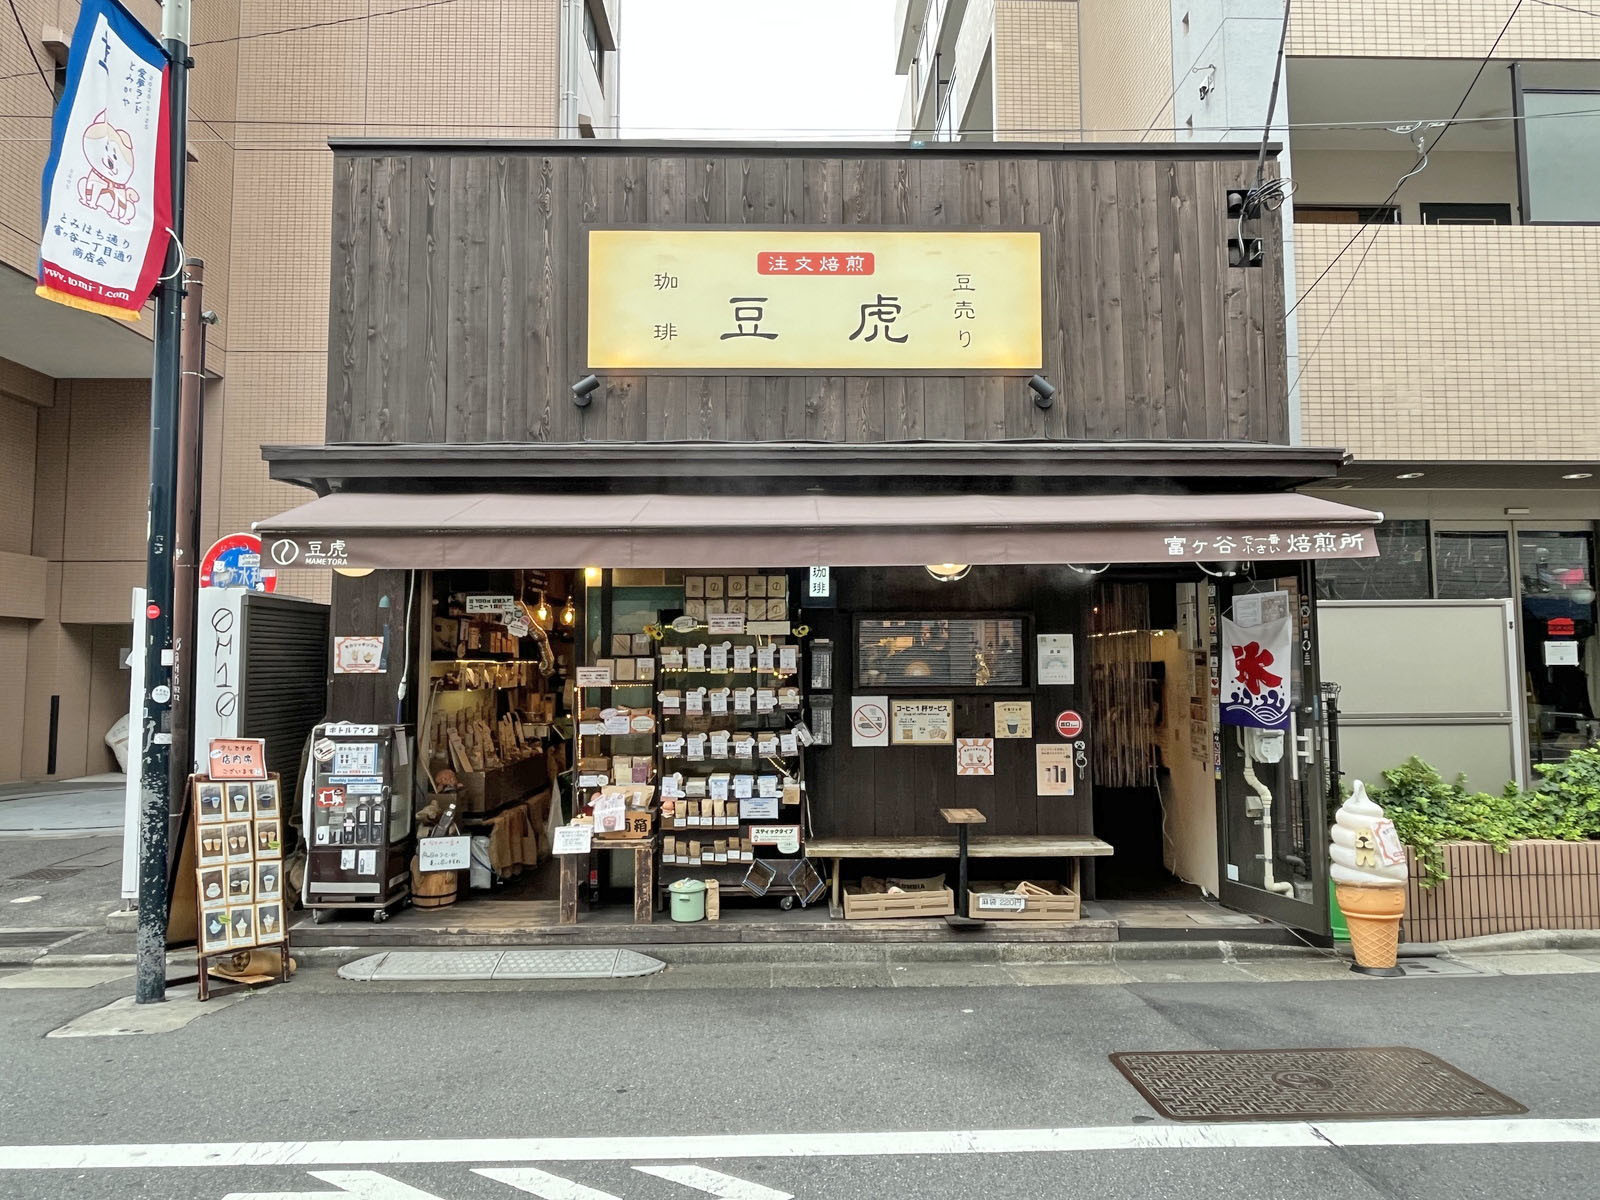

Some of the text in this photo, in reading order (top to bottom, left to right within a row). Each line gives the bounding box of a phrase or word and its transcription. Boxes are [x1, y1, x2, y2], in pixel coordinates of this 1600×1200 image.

[59, 212, 131, 249] とみはち通り
[72, 247, 107, 267] 商店会
[767, 255, 865, 273] 注文焙煎
[653, 272, 678, 342] 珈琲
[719, 293, 910, 344] 豆虎
[952, 273, 976, 349] 豆売り
[304, 540, 348, 557] 豆虎
[1287, 532, 1365, 553] 焙煎所
[305, 557, 348, 566] MAMETORA
[812, 565, 826, 594] 珈琲
[1233, 641, 1283, 695] 氷
[329, 726, 375, 734] ボトルアイス
